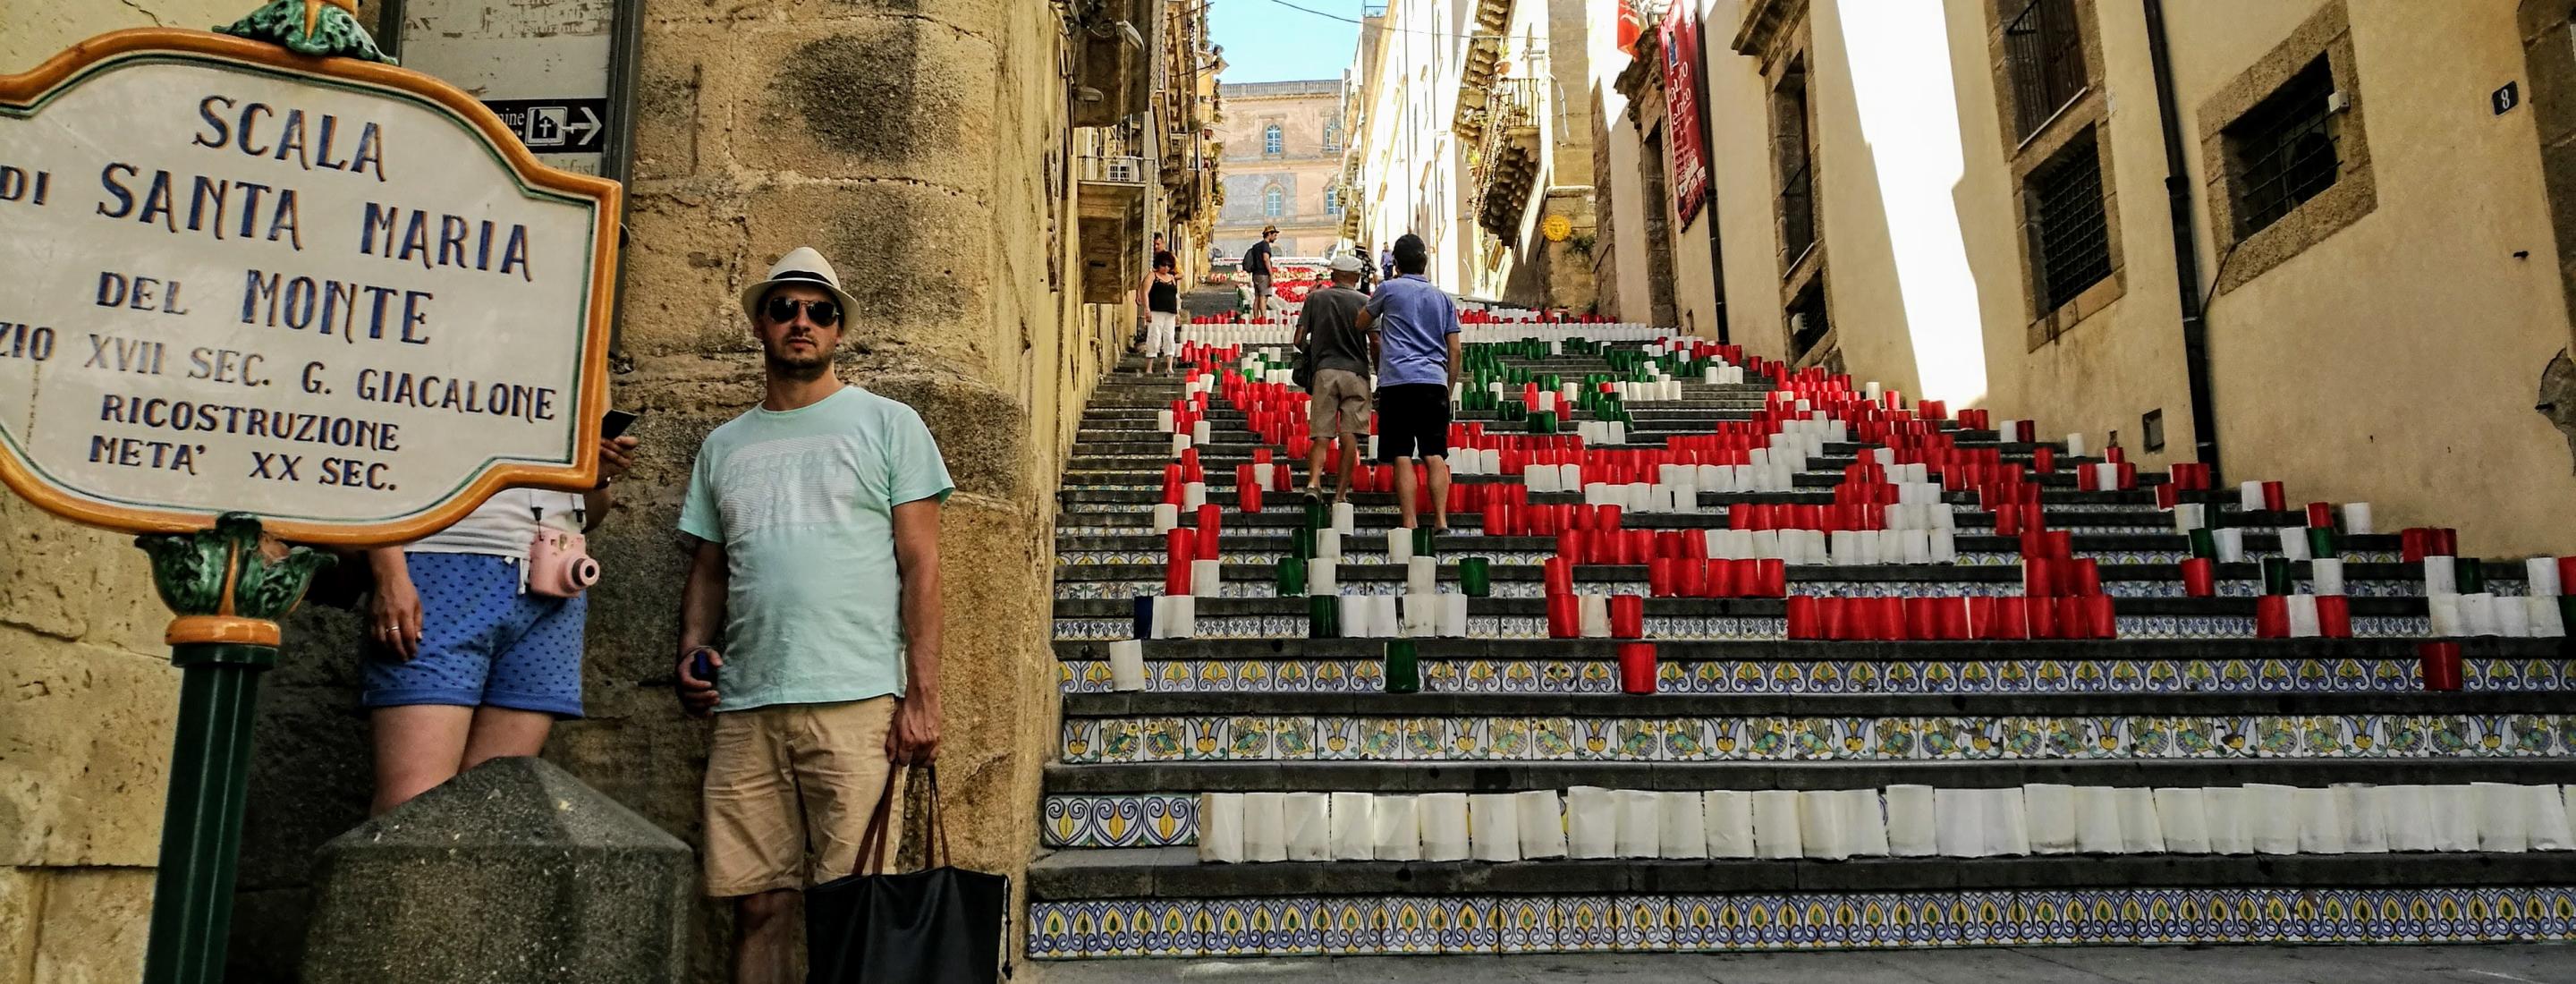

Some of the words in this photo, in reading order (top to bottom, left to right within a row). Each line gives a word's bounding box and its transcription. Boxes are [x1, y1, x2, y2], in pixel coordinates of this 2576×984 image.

[2501, 89, 2510, 109] 8
[192, 96, 386, 182] SCALA
[0, 165, 50, 206] DI
[96, 162, 302, 250] SANTA
[360, 202, 532, 281] MARIA
[96, 271, 189, 317] DEL
[242, 269, 432, 344] MONTE
[84, 335, 165, 375] XVII
[187, 347, 271, 386] SEC.
[301, 361, 332, 394] G.
[358, 369, 555, 423] GIACALONE
[101, 394, 400, 451] RICOSTRUZIONE
[250, 452, 304, 481] XX
[319, 457, 397, 491] SEC.
